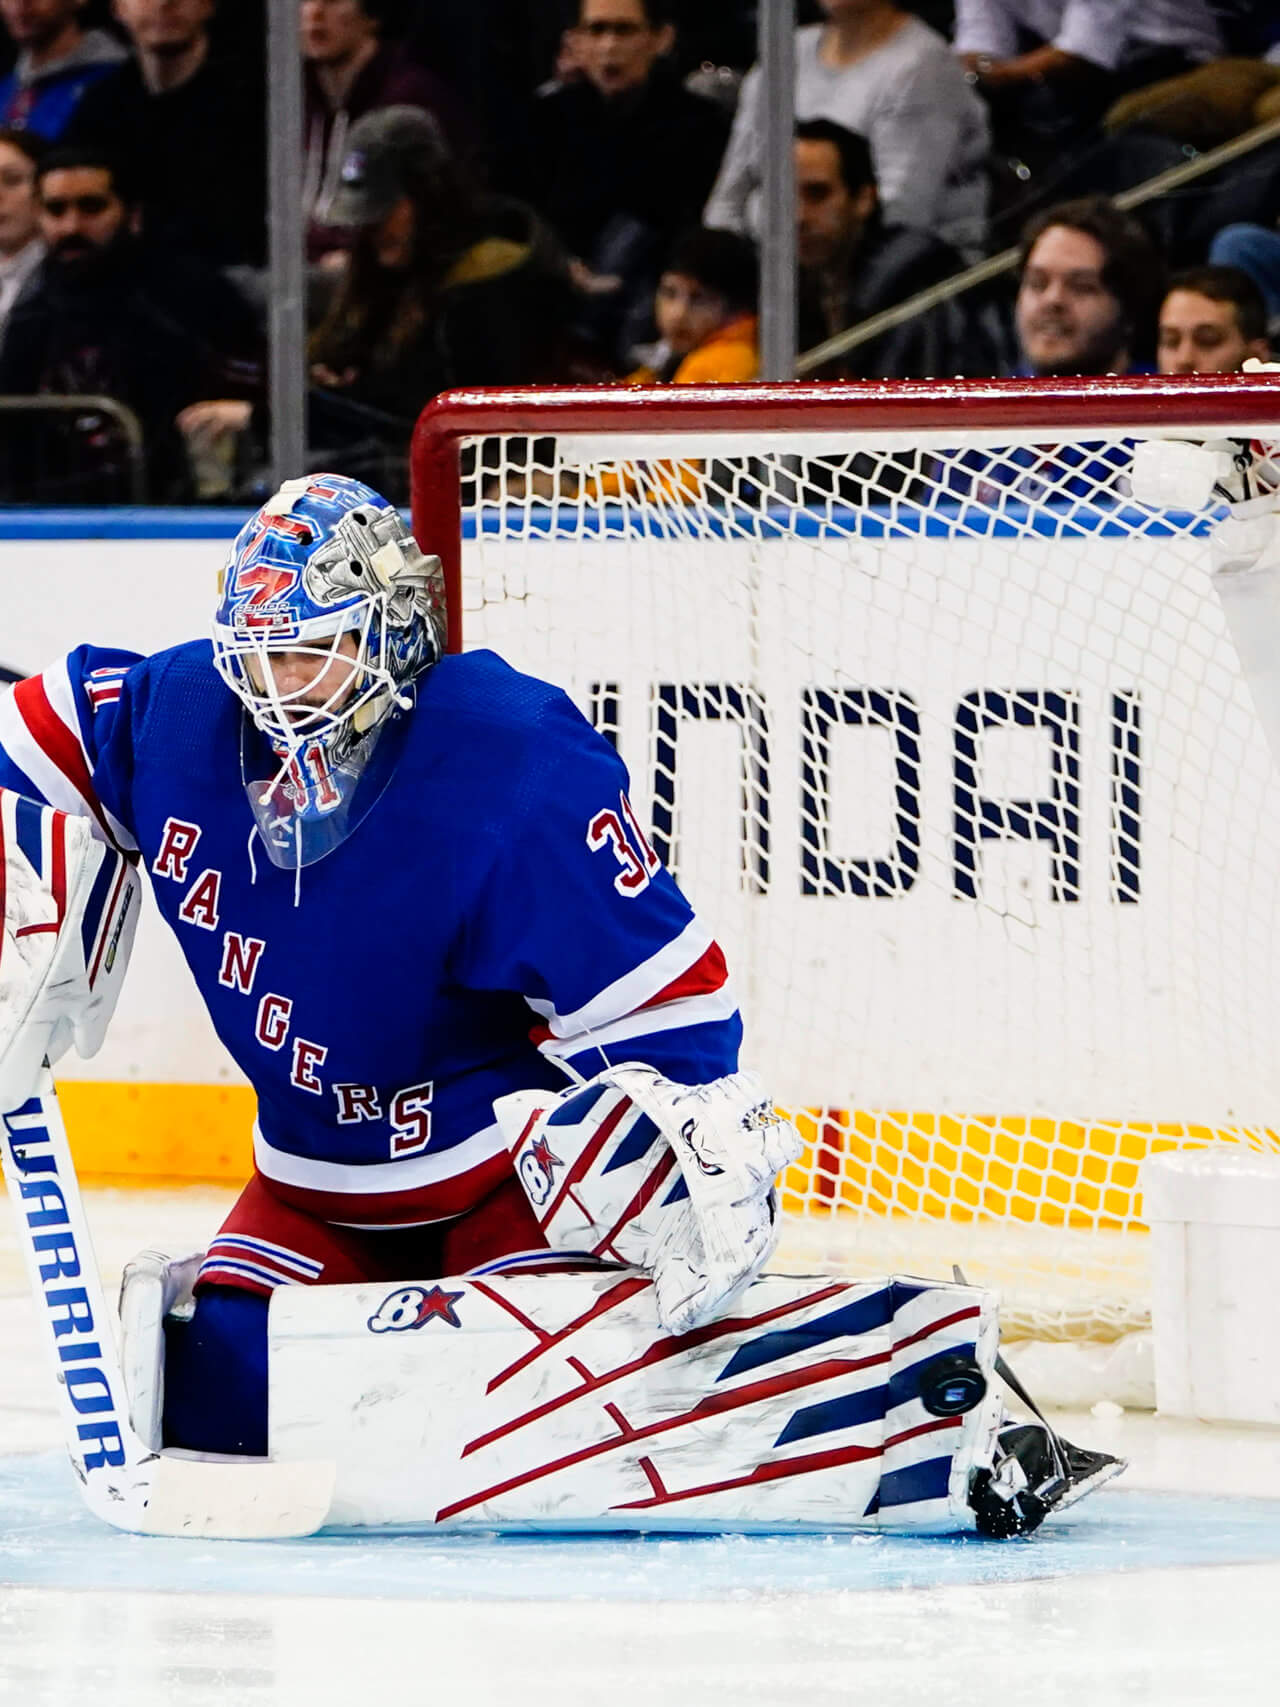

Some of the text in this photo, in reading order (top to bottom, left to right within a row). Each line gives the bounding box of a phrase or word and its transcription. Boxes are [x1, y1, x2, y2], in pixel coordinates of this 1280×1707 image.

[153, 816, 435, 1159] RANGERS
[586, 789, 662, 899] 31
[3, 1096, 127, 1474] WARRIOR
